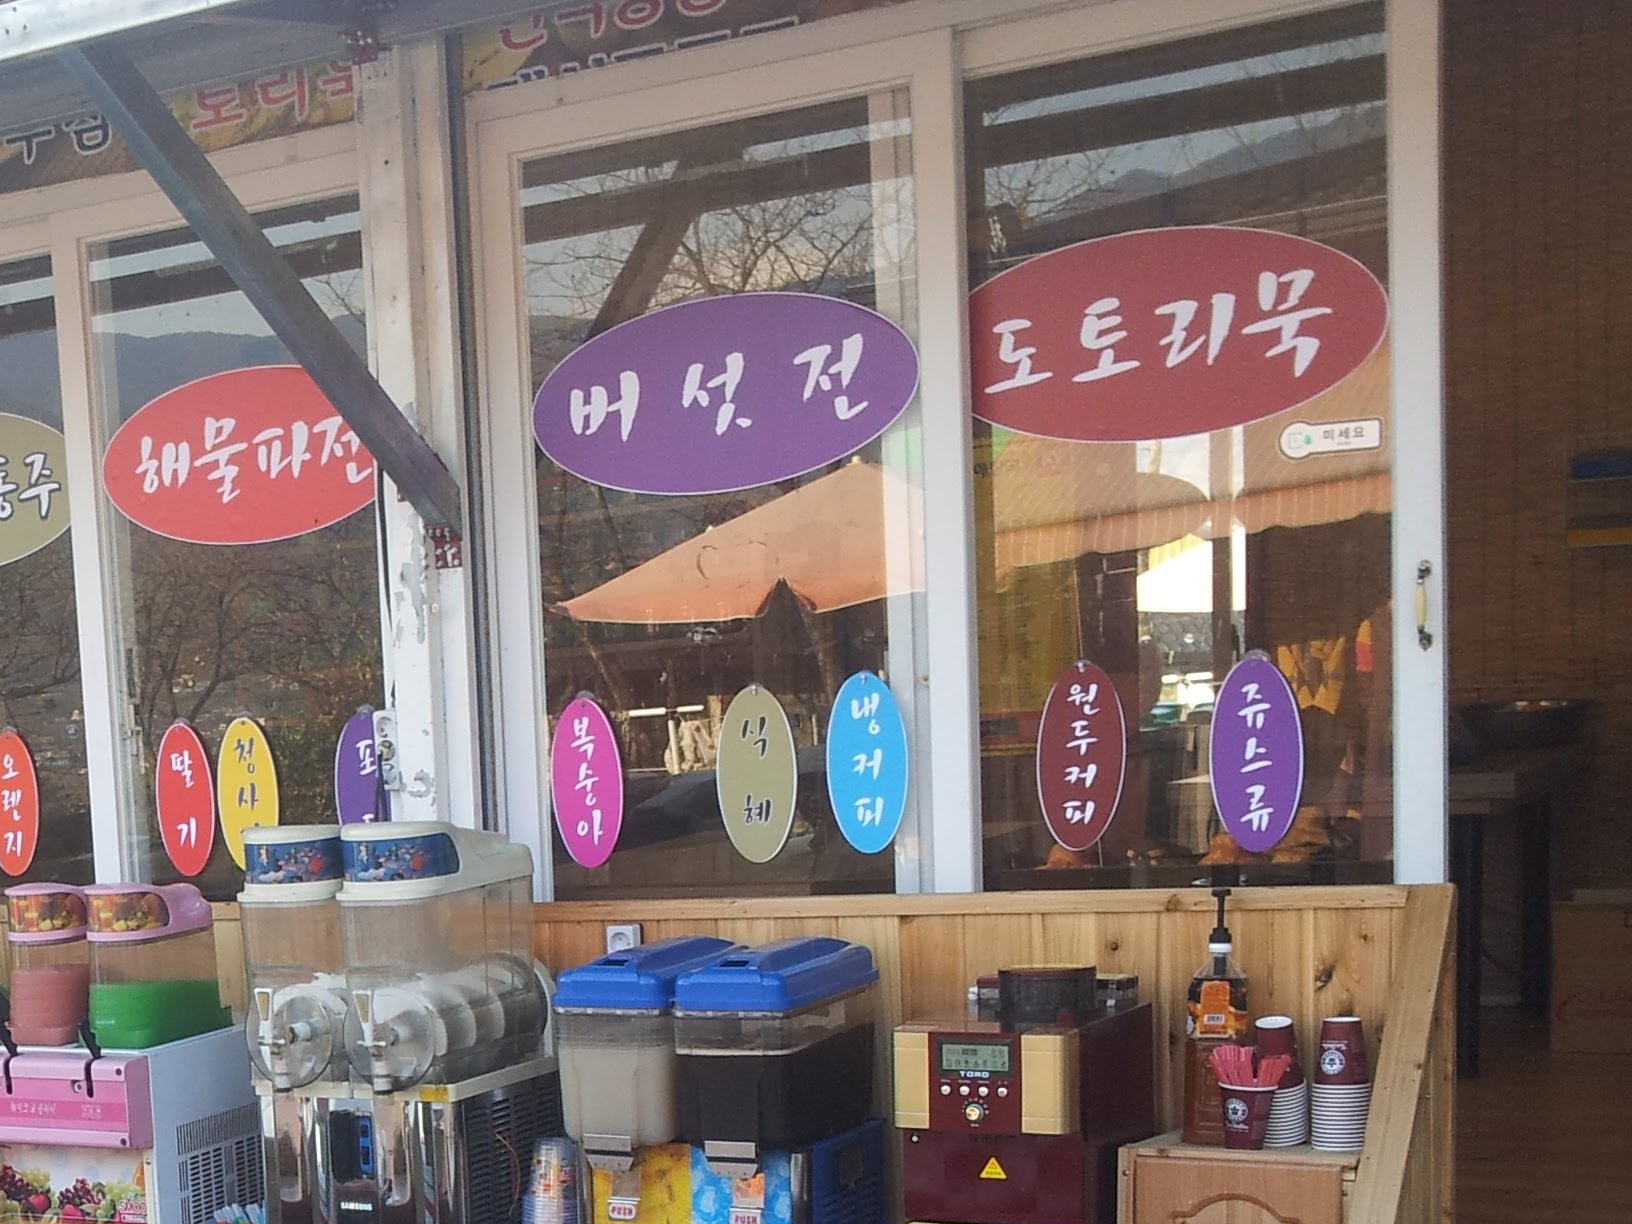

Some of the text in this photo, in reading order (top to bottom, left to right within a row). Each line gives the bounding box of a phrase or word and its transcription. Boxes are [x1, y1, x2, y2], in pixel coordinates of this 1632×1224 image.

[984, 269, 1333, 396] 도토리묵
[570, 333, 870, 445] 버섯전
[135, 416, 376, 504] 해물파전
[2, 754, 24, 859] 오렌지
[171, 752, 197, 849] 딸기
[234, 737, 260, 833] 청사
[571, 716, 603, 847] 복숭아
[741, 716, 771, 825] 식혜
[851, 693, 884, 828] 냉커피
[1063, 683, 1099, 825] 원두커피
[1238, 683, 1274, 832] 쥬스류
[611, 1206, 633, 1216] PUSH
[734, 1215, 757, 1224] PUSH
